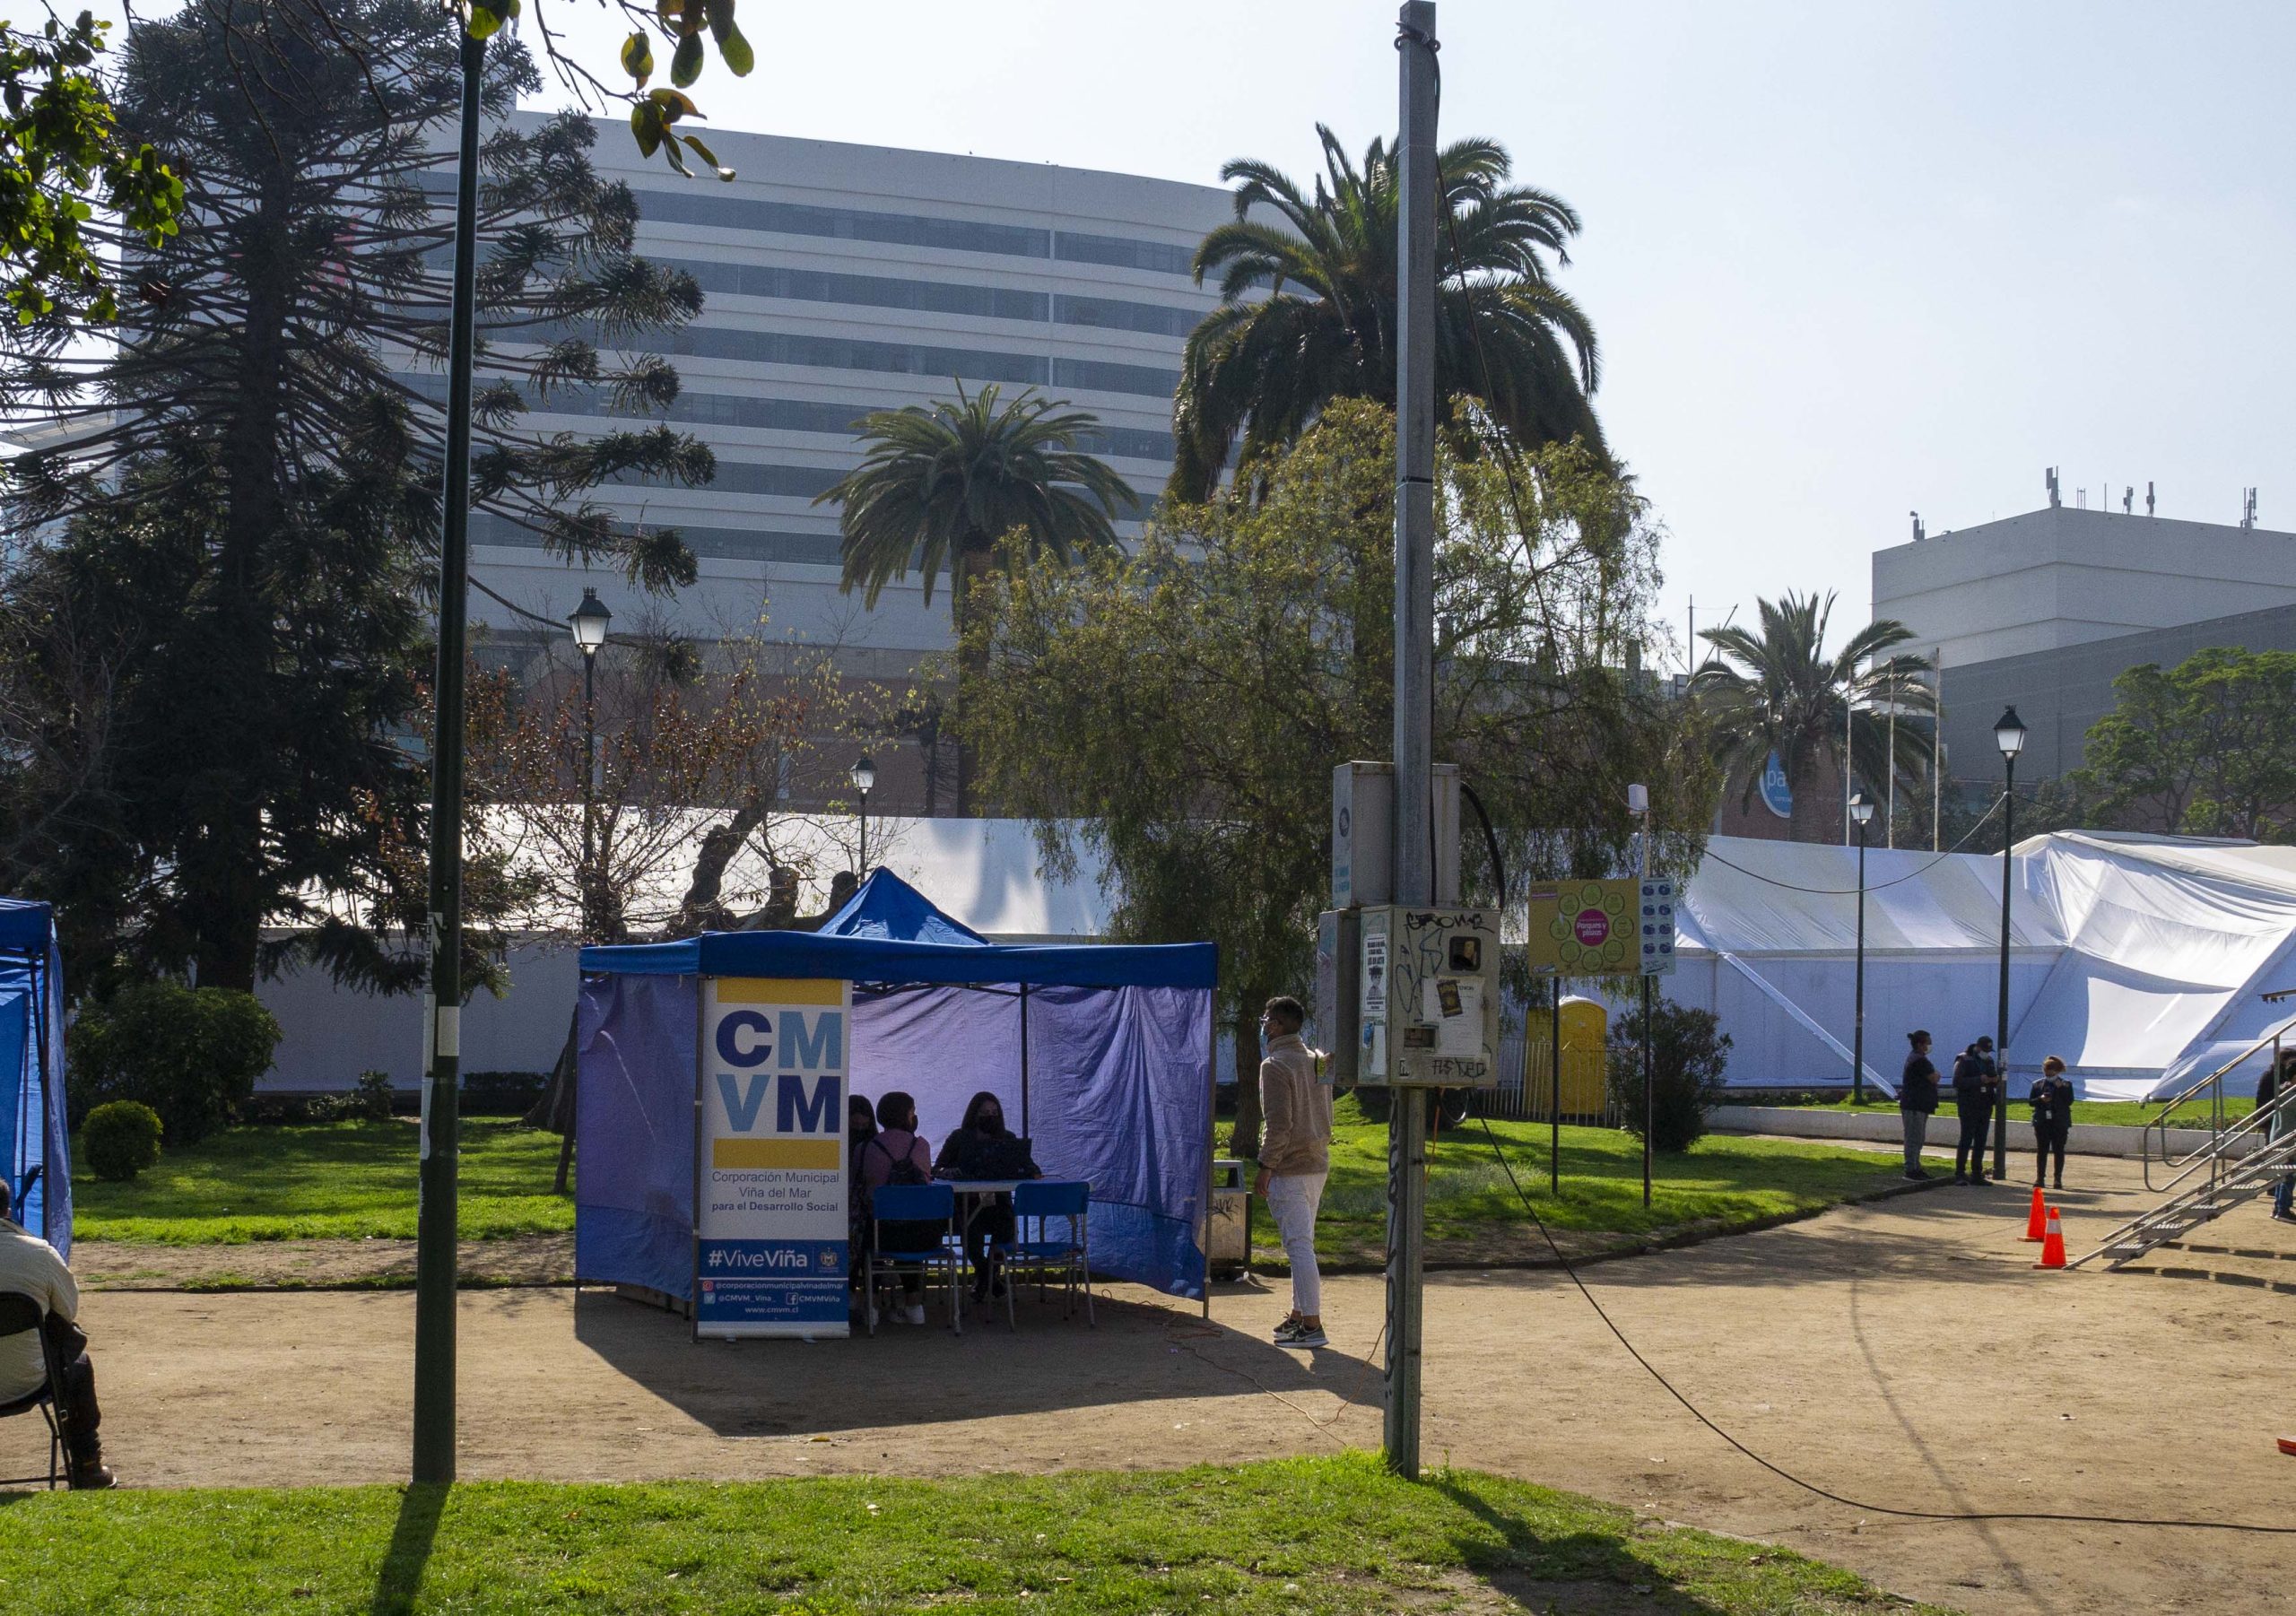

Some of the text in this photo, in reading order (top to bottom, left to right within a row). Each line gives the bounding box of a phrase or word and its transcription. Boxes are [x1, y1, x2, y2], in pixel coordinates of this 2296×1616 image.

[716, 1010, 842, 1069] CM
[716, 1074, 841, 1134] VM
[712, 1171, 839, 1184] Corporación Municipal
[739, 1187, 812, 1198] Viña del Mar
[712, 1202, 839, 1212] para el Desarrollo Social
[709, 1249, 807, 1267] #ViveViña
